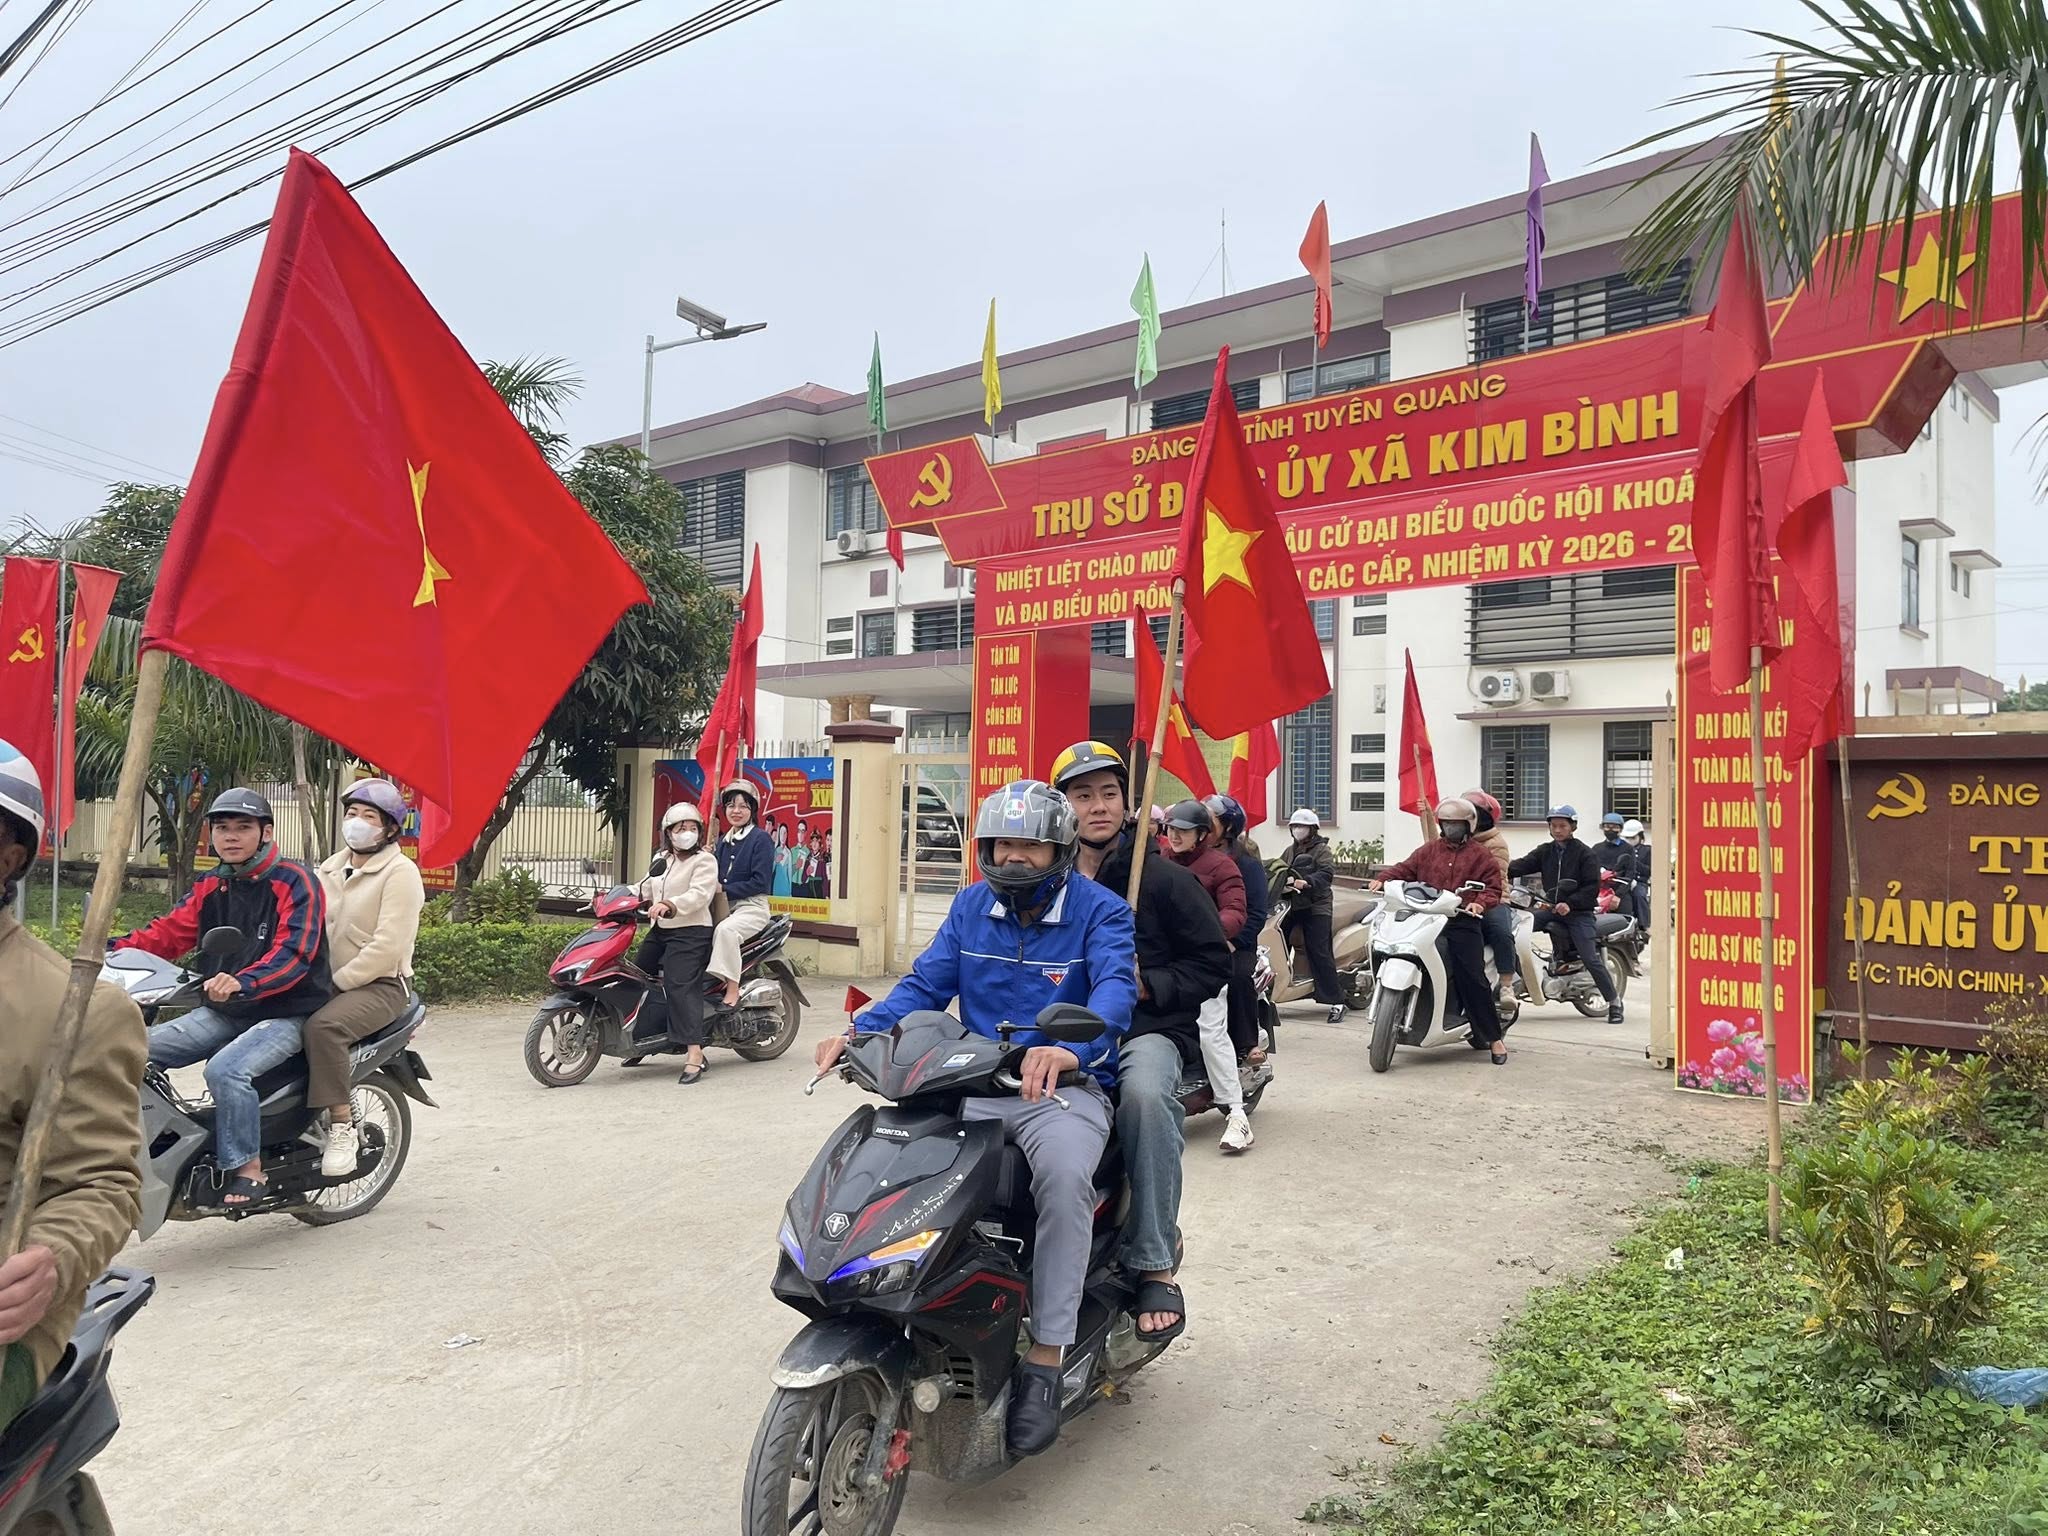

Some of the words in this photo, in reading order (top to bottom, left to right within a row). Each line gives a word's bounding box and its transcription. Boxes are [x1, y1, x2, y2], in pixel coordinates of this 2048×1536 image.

[1131, 436, 1196, 465] ĐẢNG
[1243, 415, 1294, 444] TỈNH
[1302, 397, 1383, 432] TUYÊN
[1393, 374, 1507, 416] QUANG
[1032, 496, 1094, 539] TRỤ
[1103, 473, 1152, 527] SỞ
[1277, 444, 1333, 498] ỦY
[1347, 432, 1412, 488] XÃ
[1428, 419, 1527, 475] KIM
[1542, 390, 1679, 457] BÌNH
[995, 564, 1043, 593] NHIỆT
[1047, 558, 1083, 588] LIỆT
[1087, 552, 1136, 581] CHÀO
[1284, 522, 1312, 554] ẦU
[1319, 515, 1353, 550] CỬ
[1356, 516, 1398, 547] ĐẠI
[1406, 499, 1464, 539] BIỂU
[1472, 487, 1546, 532] QUỐC
[1554, 483, 1603, 522] HỘI
[1613, 468, 1695, 512] KHOÁ
[995, 601, 1016, 626] VÀ
[1020, 601, 1048, 626] ĐẠI
[1052, 588, 1092, 620] BIỂU
[1097, 588, 1127, 618] HỘI
[1133, 580, 1172, 610] ĐỒN
[1308, 560, 1355, 592] CÁC
[1362, 549, 1414, 586] CẤP,
[1422, 542, 1509, 579] NHIỆM
[1518, 534, 1554, 569] KỲ
[1562, 530, 1634, 564] 2026
[990, 644, 1004, 668] TẬN
[1005, 643, 1020, 665] TÂM
[990, 674, 1004, 699] TẬN
[1005, 673, 1019, 698] LỰC
[985, 701, 1004, 726] CỐNG
[1005, 700, 1022, 725] HIẾN
[1695, 713, 1719, 745] ĐẠI
[1722, 707, 1751, 739] ĐOÀ
[988, 734, 996, 755] VÌ
[980, 764, 988, 786] VÌ
[989, 761, 1003, 786] ĐẤT
[1692, 752, 1729, 784] TOÀN
[1732, 752, 1755, 784] DÂ
[1949, 775, 2041, 806] ĐẢNG
[1703, 796, 1719, 828] LÀ
[1701, 837, 1745, 875] QUYẾT
[1704, 886, 1751, 918] THÀNH
[1844, 880, 1977, 949] ĐẢNG
[1690, 927, 1718, 961] CỦA
[1721, 931, 1741, 967] SỰ
[1743, 934, 1796, 971] NGIỆP
[1896, 962, 1953, 989] THÔN
[1958, 969, 2024, 995] CHINH
[1700, 975, 1739, 1008] CÁCH
[1742, 981, 1784, 1015] MẠG
[875, 1127, 910, 1138] HONDA
